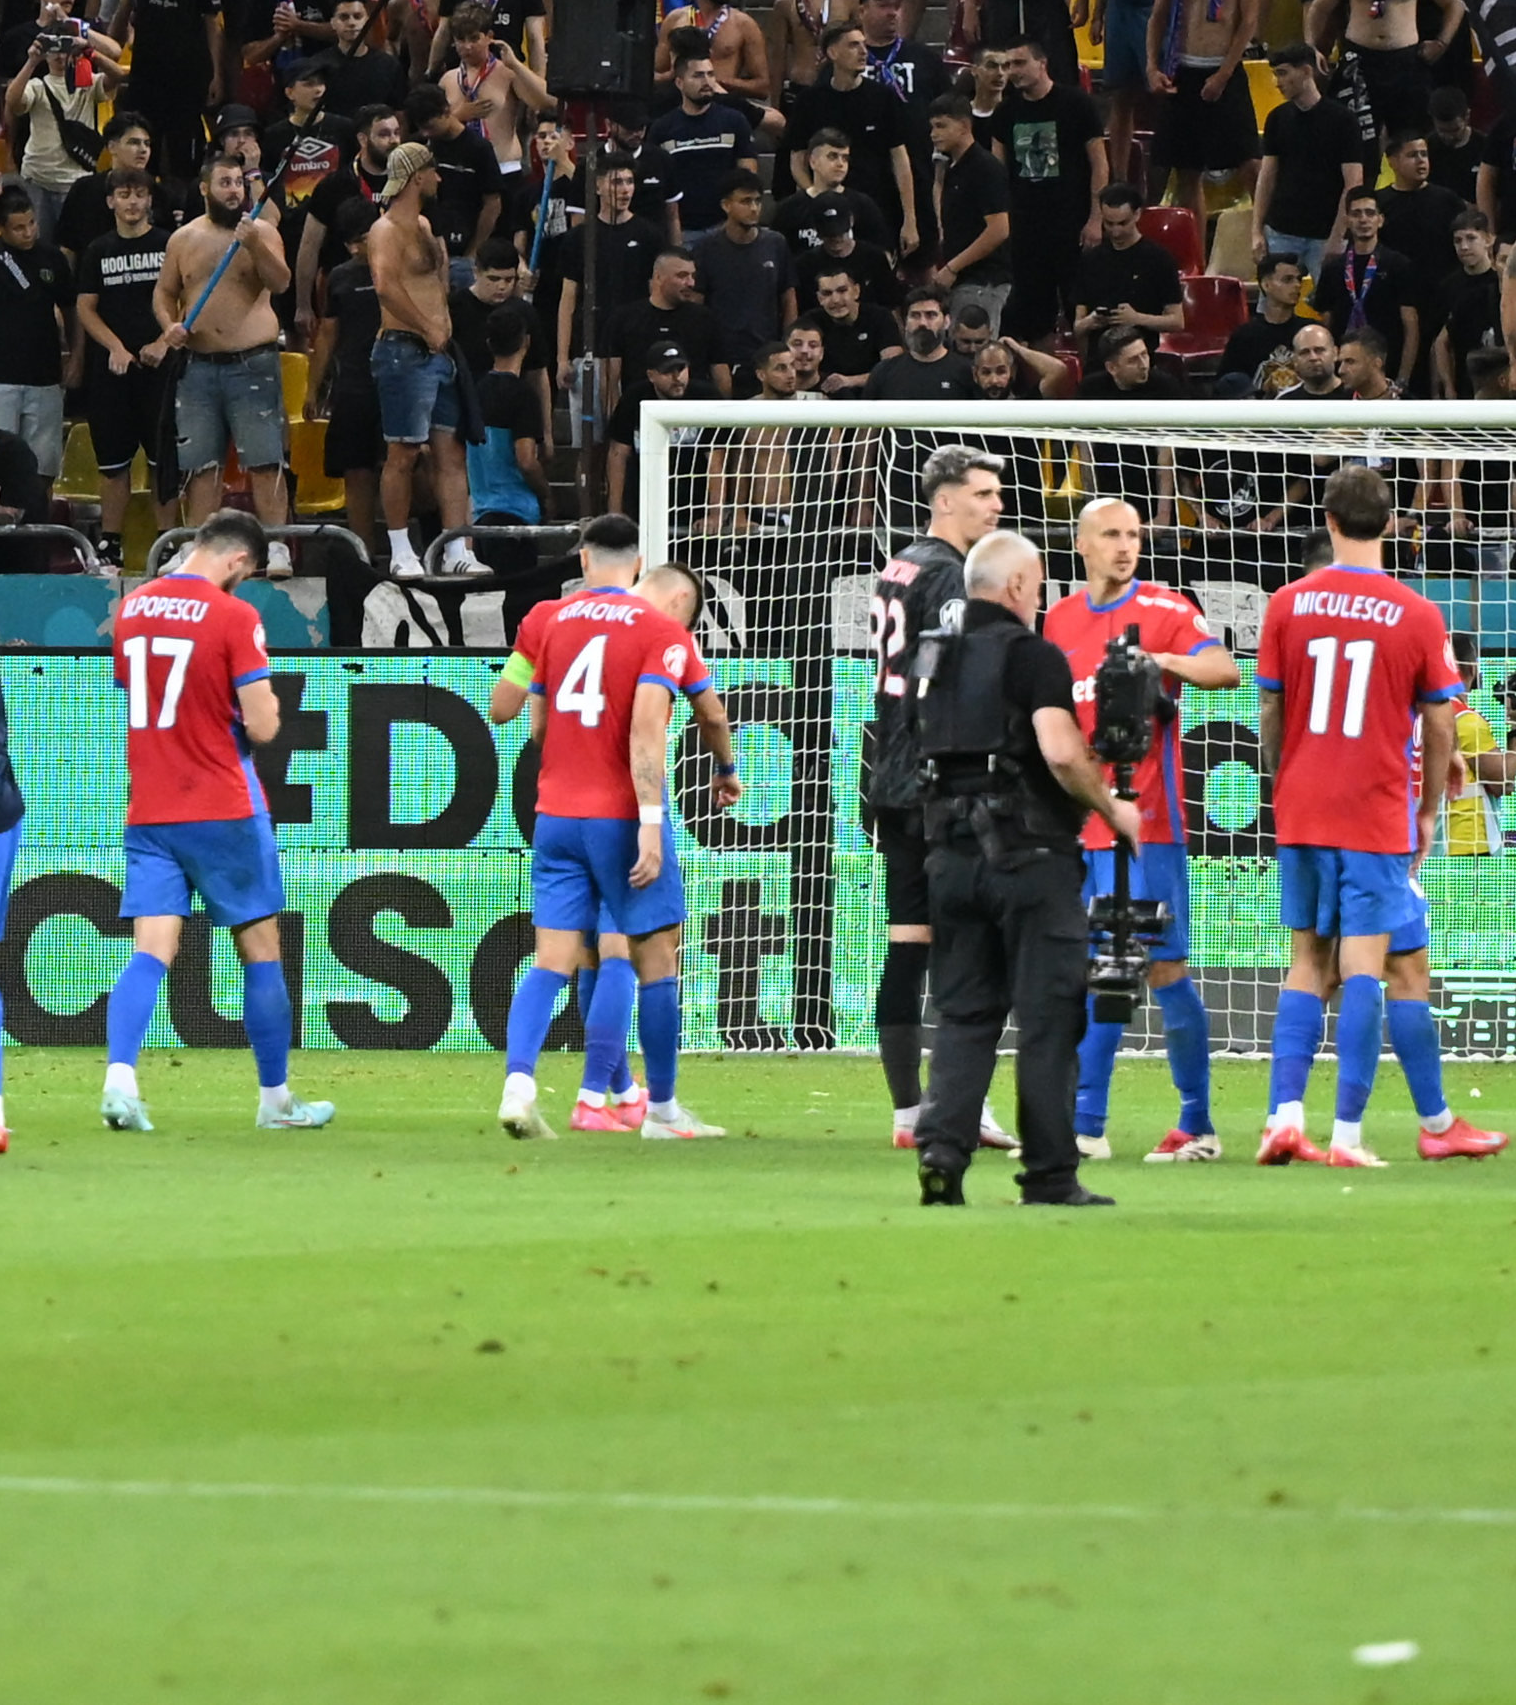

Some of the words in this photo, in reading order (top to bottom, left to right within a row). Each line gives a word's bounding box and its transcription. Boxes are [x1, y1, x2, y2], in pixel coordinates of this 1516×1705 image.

[290, 160, 331, 173] umbro
[100, 251, 166, 274] HOOLIGANS
[558, 601, 644, 628] GRAOVAC
[1292, 591, 1404, 628] MICULESCU
[121, 635, 196, 731] 17
[555, 634, 609, 728] 4
[1306, 635, 1376, 739] 11
